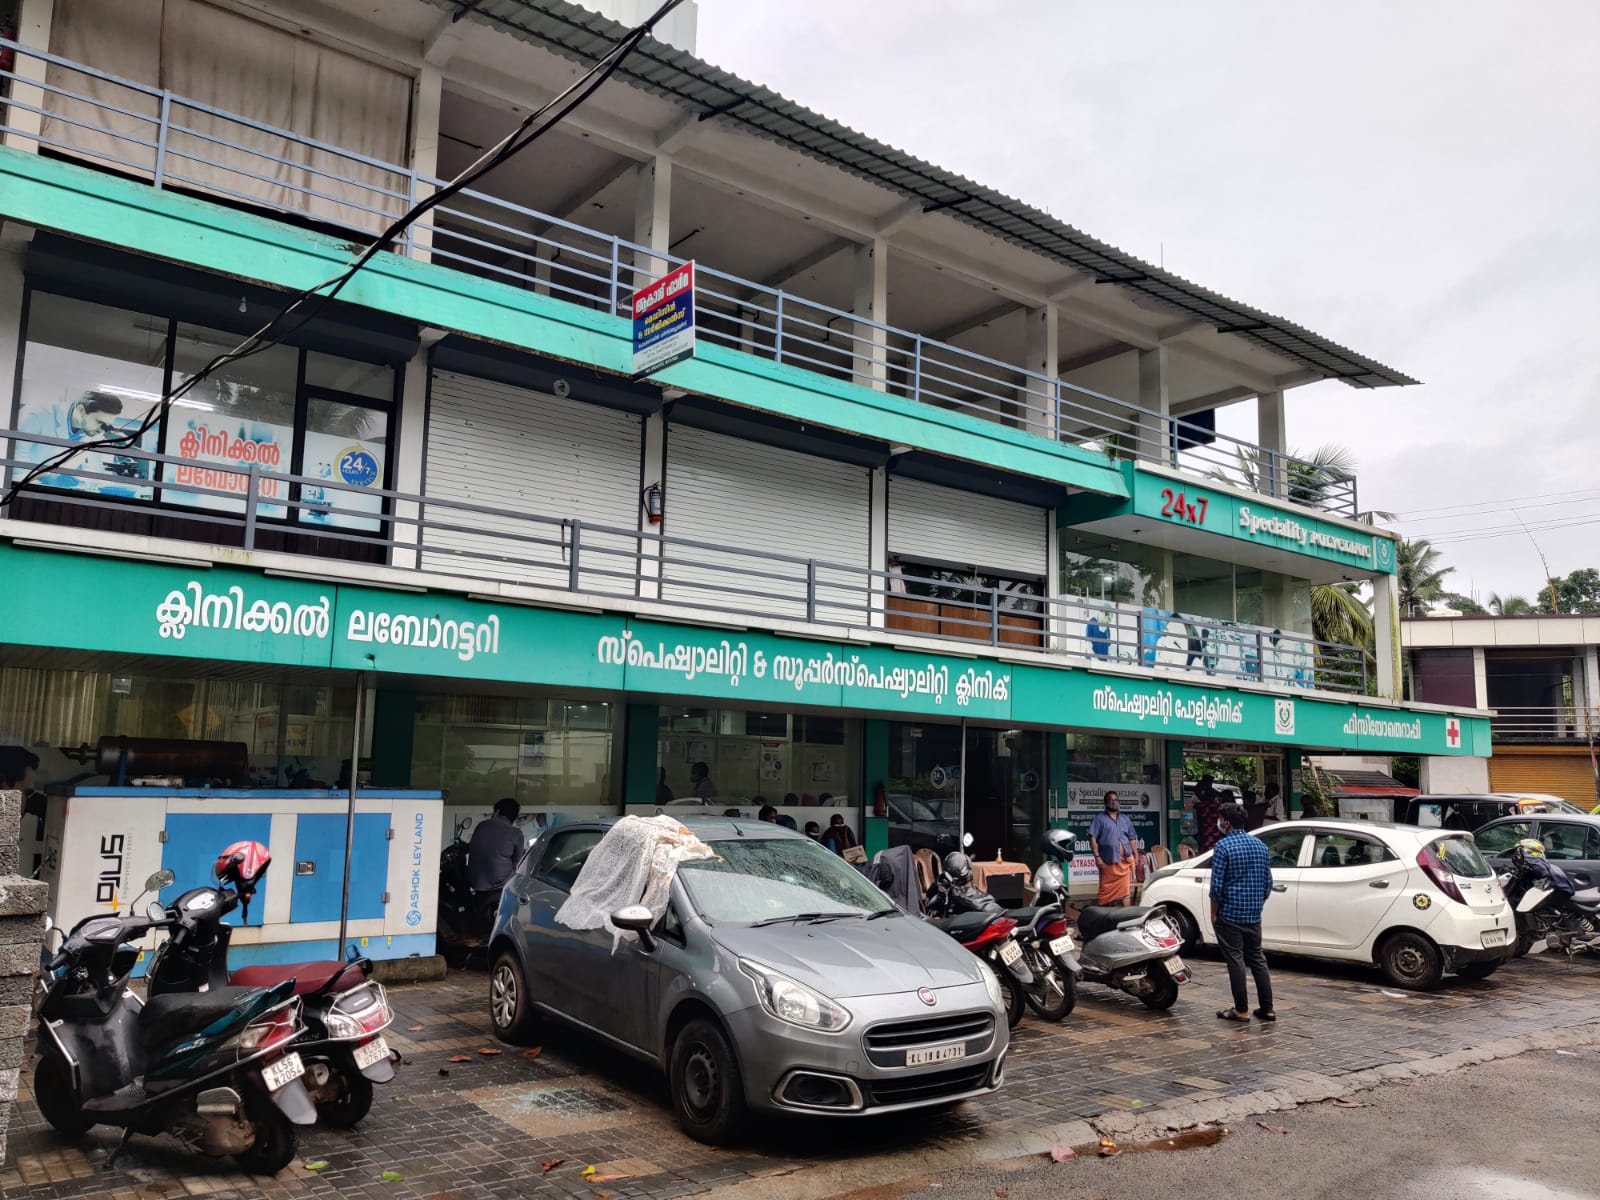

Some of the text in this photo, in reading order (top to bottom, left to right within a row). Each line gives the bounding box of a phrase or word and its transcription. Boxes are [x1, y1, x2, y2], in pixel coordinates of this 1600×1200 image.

[179, 426, 280, 466] ക്ലിനിക്കൽ
[1161, 488, 1208, 524] 24x7
[1240, 507, 1307, 545] Speciality
[156, 581, 499, 661] ക്ലിനിക്കൽ ലബോറട്ടറി
[597, 630, 1010, 706] സ്പെഷ്യാലിറ്റി & സൂപ്പർസ്പെഷ്യാലിറ്റി ക്ലിനിക്
[1093, 685, 1244, 729] സ്പെഷ്യാലിറ്റി പോളിക്ലിനിക്
[411, 813, 424, 909] ASHOK LEYLAND
